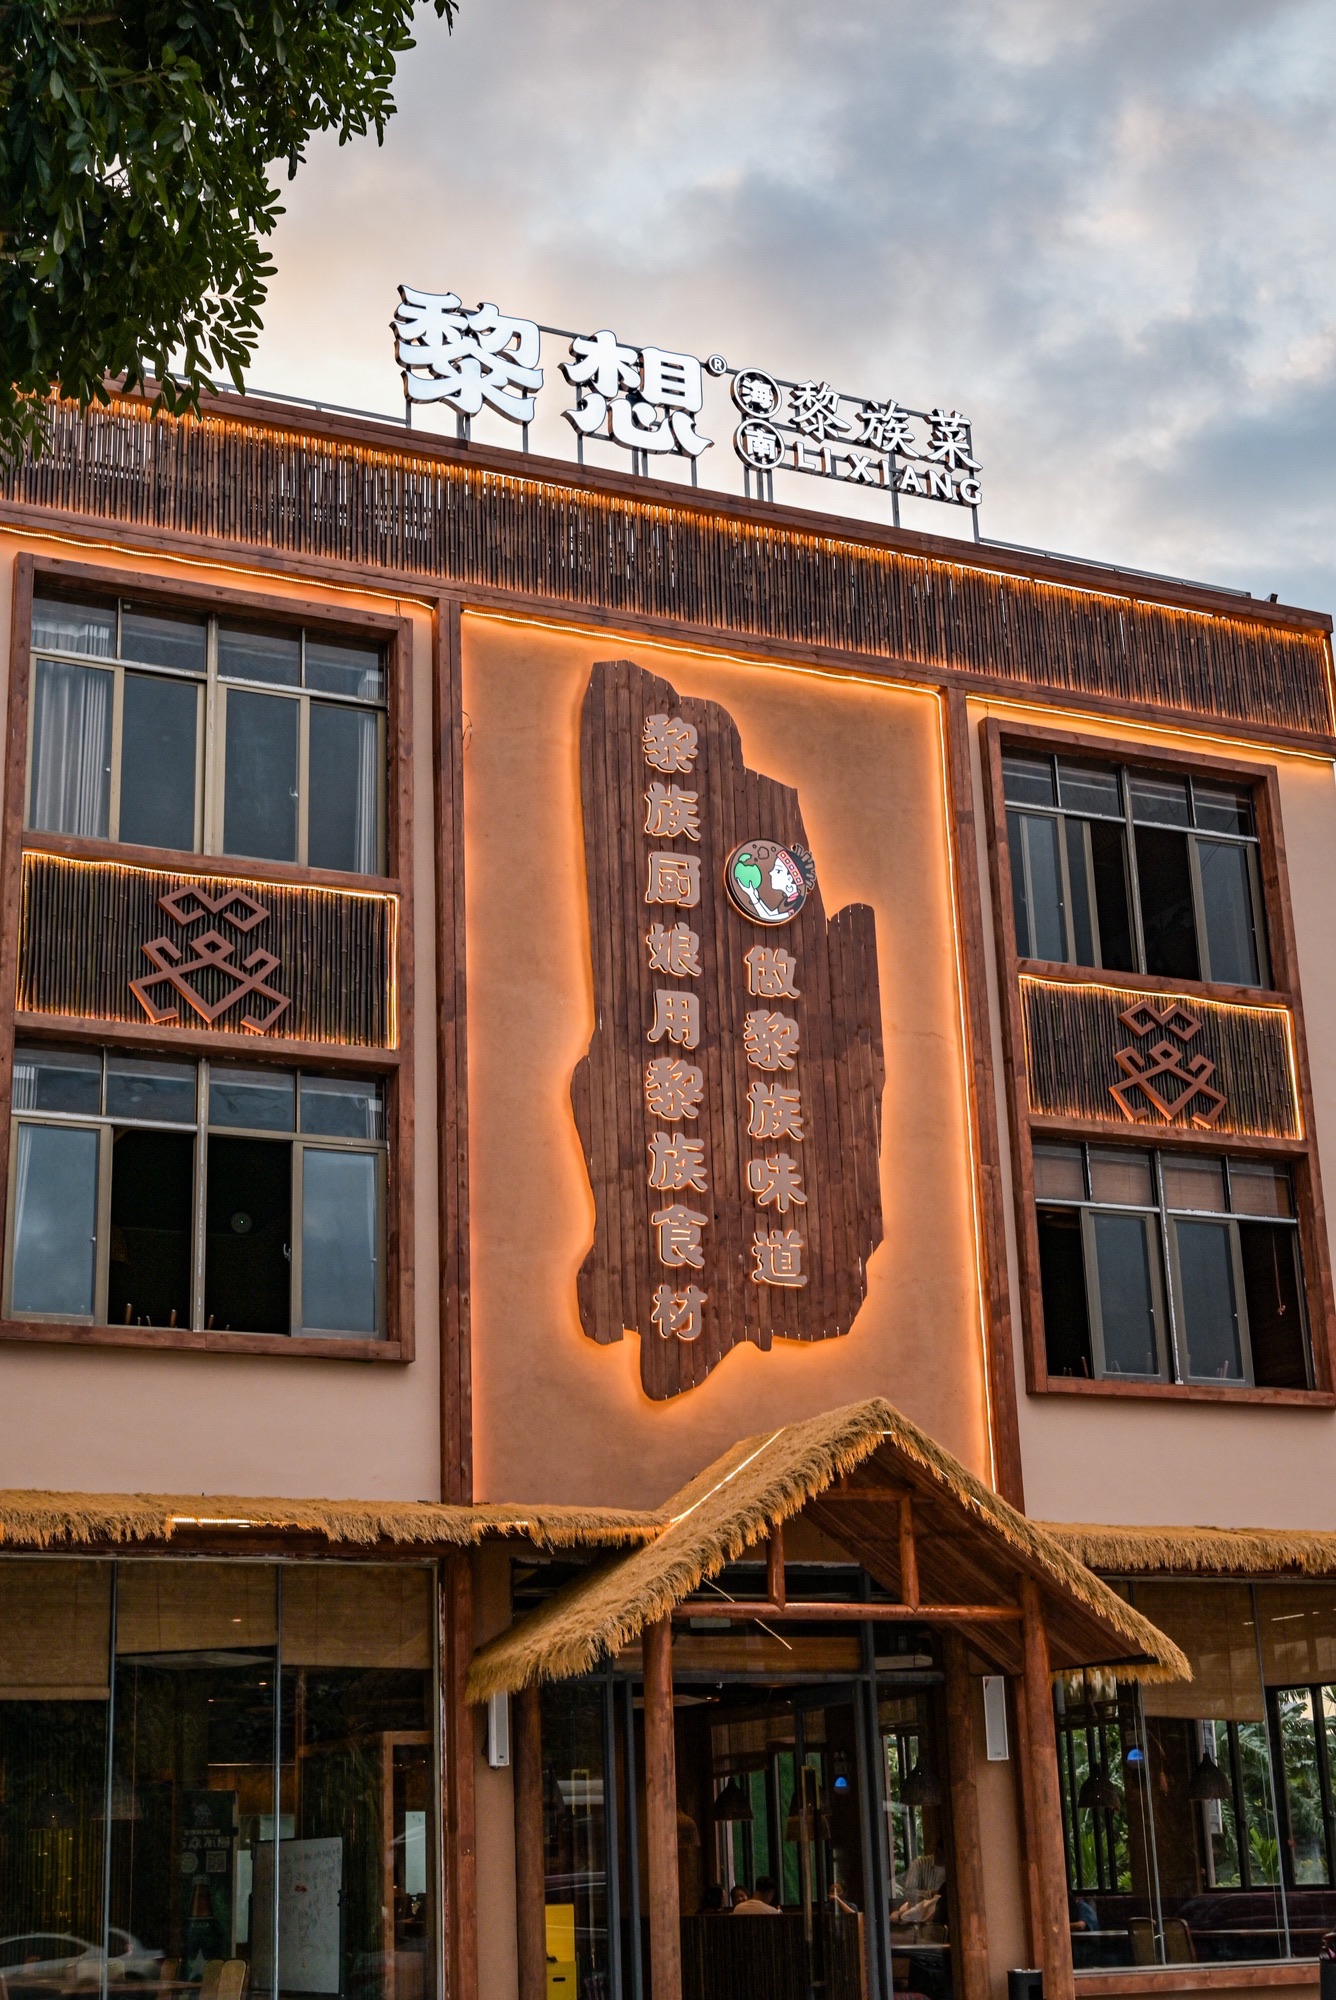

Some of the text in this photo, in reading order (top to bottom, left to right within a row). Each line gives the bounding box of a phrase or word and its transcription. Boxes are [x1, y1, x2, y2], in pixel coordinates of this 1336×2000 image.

[389, 284, 715, 457] 黎想
[788, 380, 983, 472] 黎族菜
[793, 441, 982, 506] LIXIANG
[642, 713, 709, 1341] 黎族厨娘用黎族食材
[744, 944, 808, 1287] 做黎族味道
